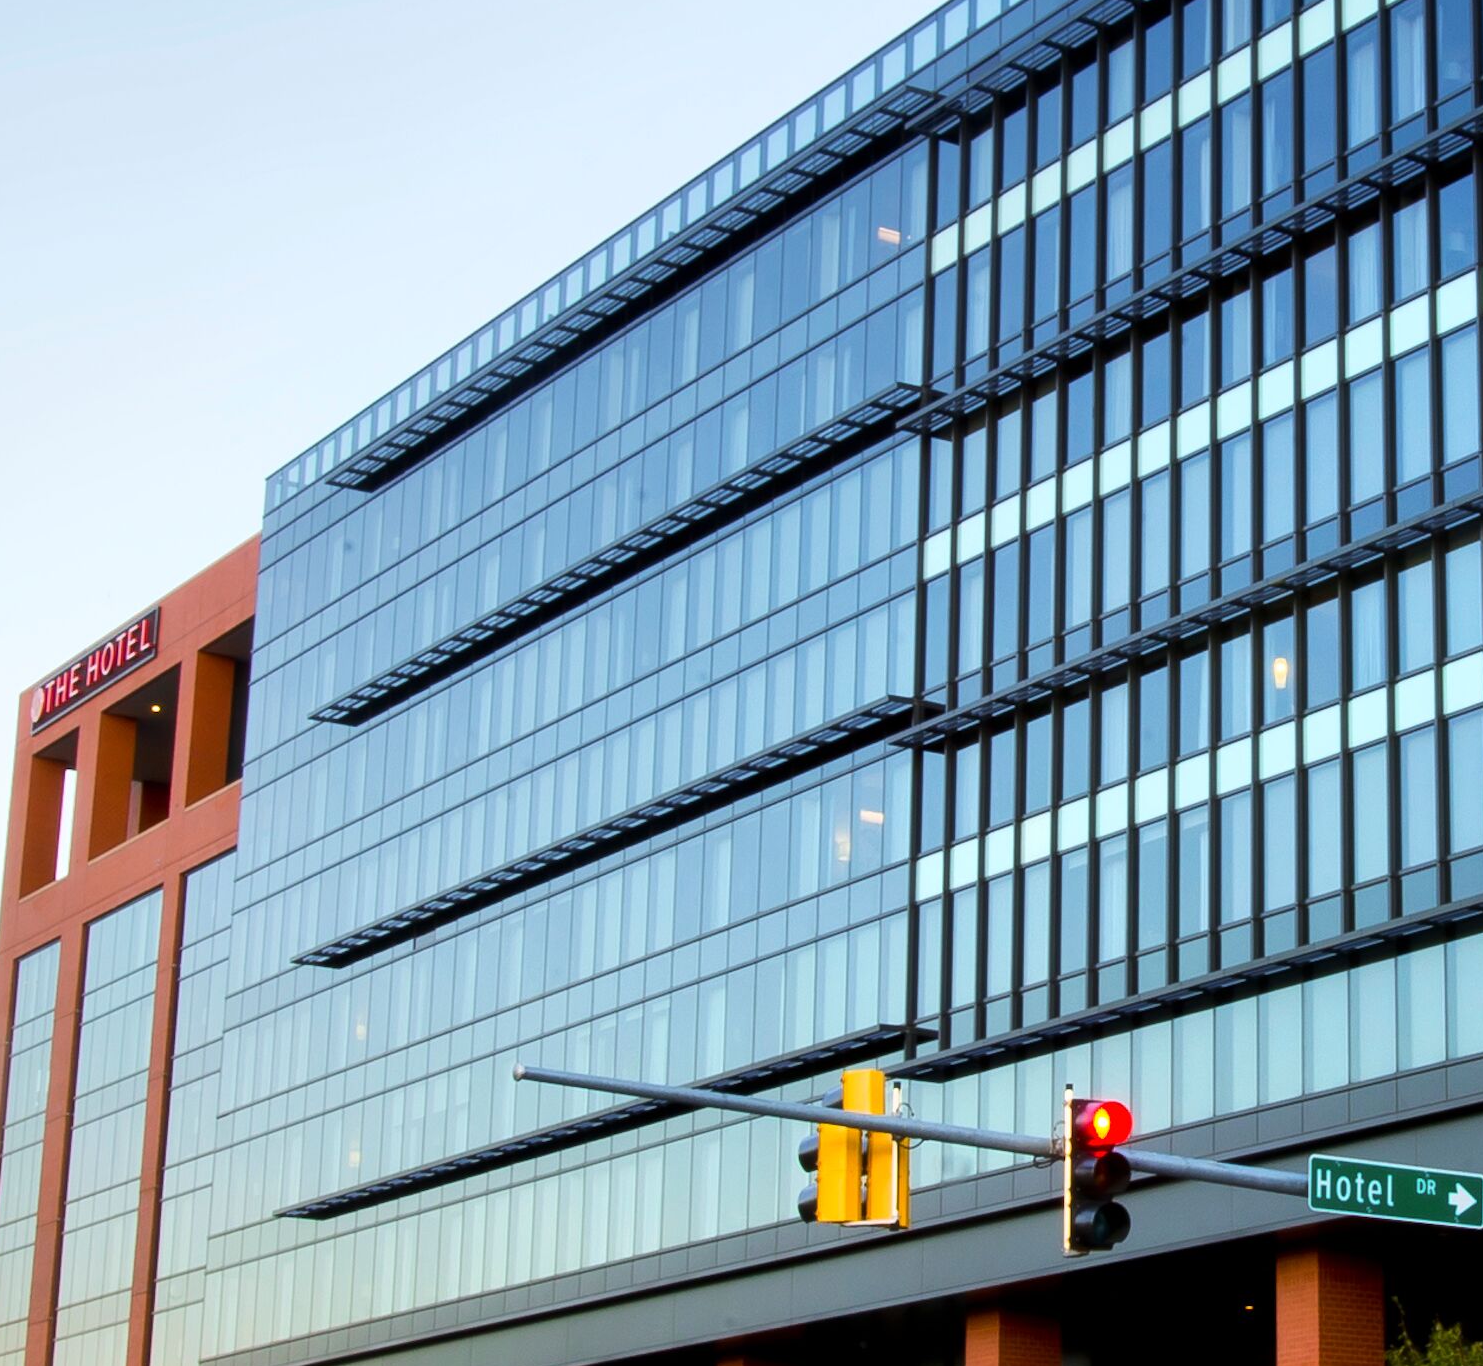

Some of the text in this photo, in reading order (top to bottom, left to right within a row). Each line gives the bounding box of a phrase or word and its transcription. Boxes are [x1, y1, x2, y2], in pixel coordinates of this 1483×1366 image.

[45, 618, 152, 713] THE HOTEL
[1316, 1168, 1437, 1207] Hotel DR
